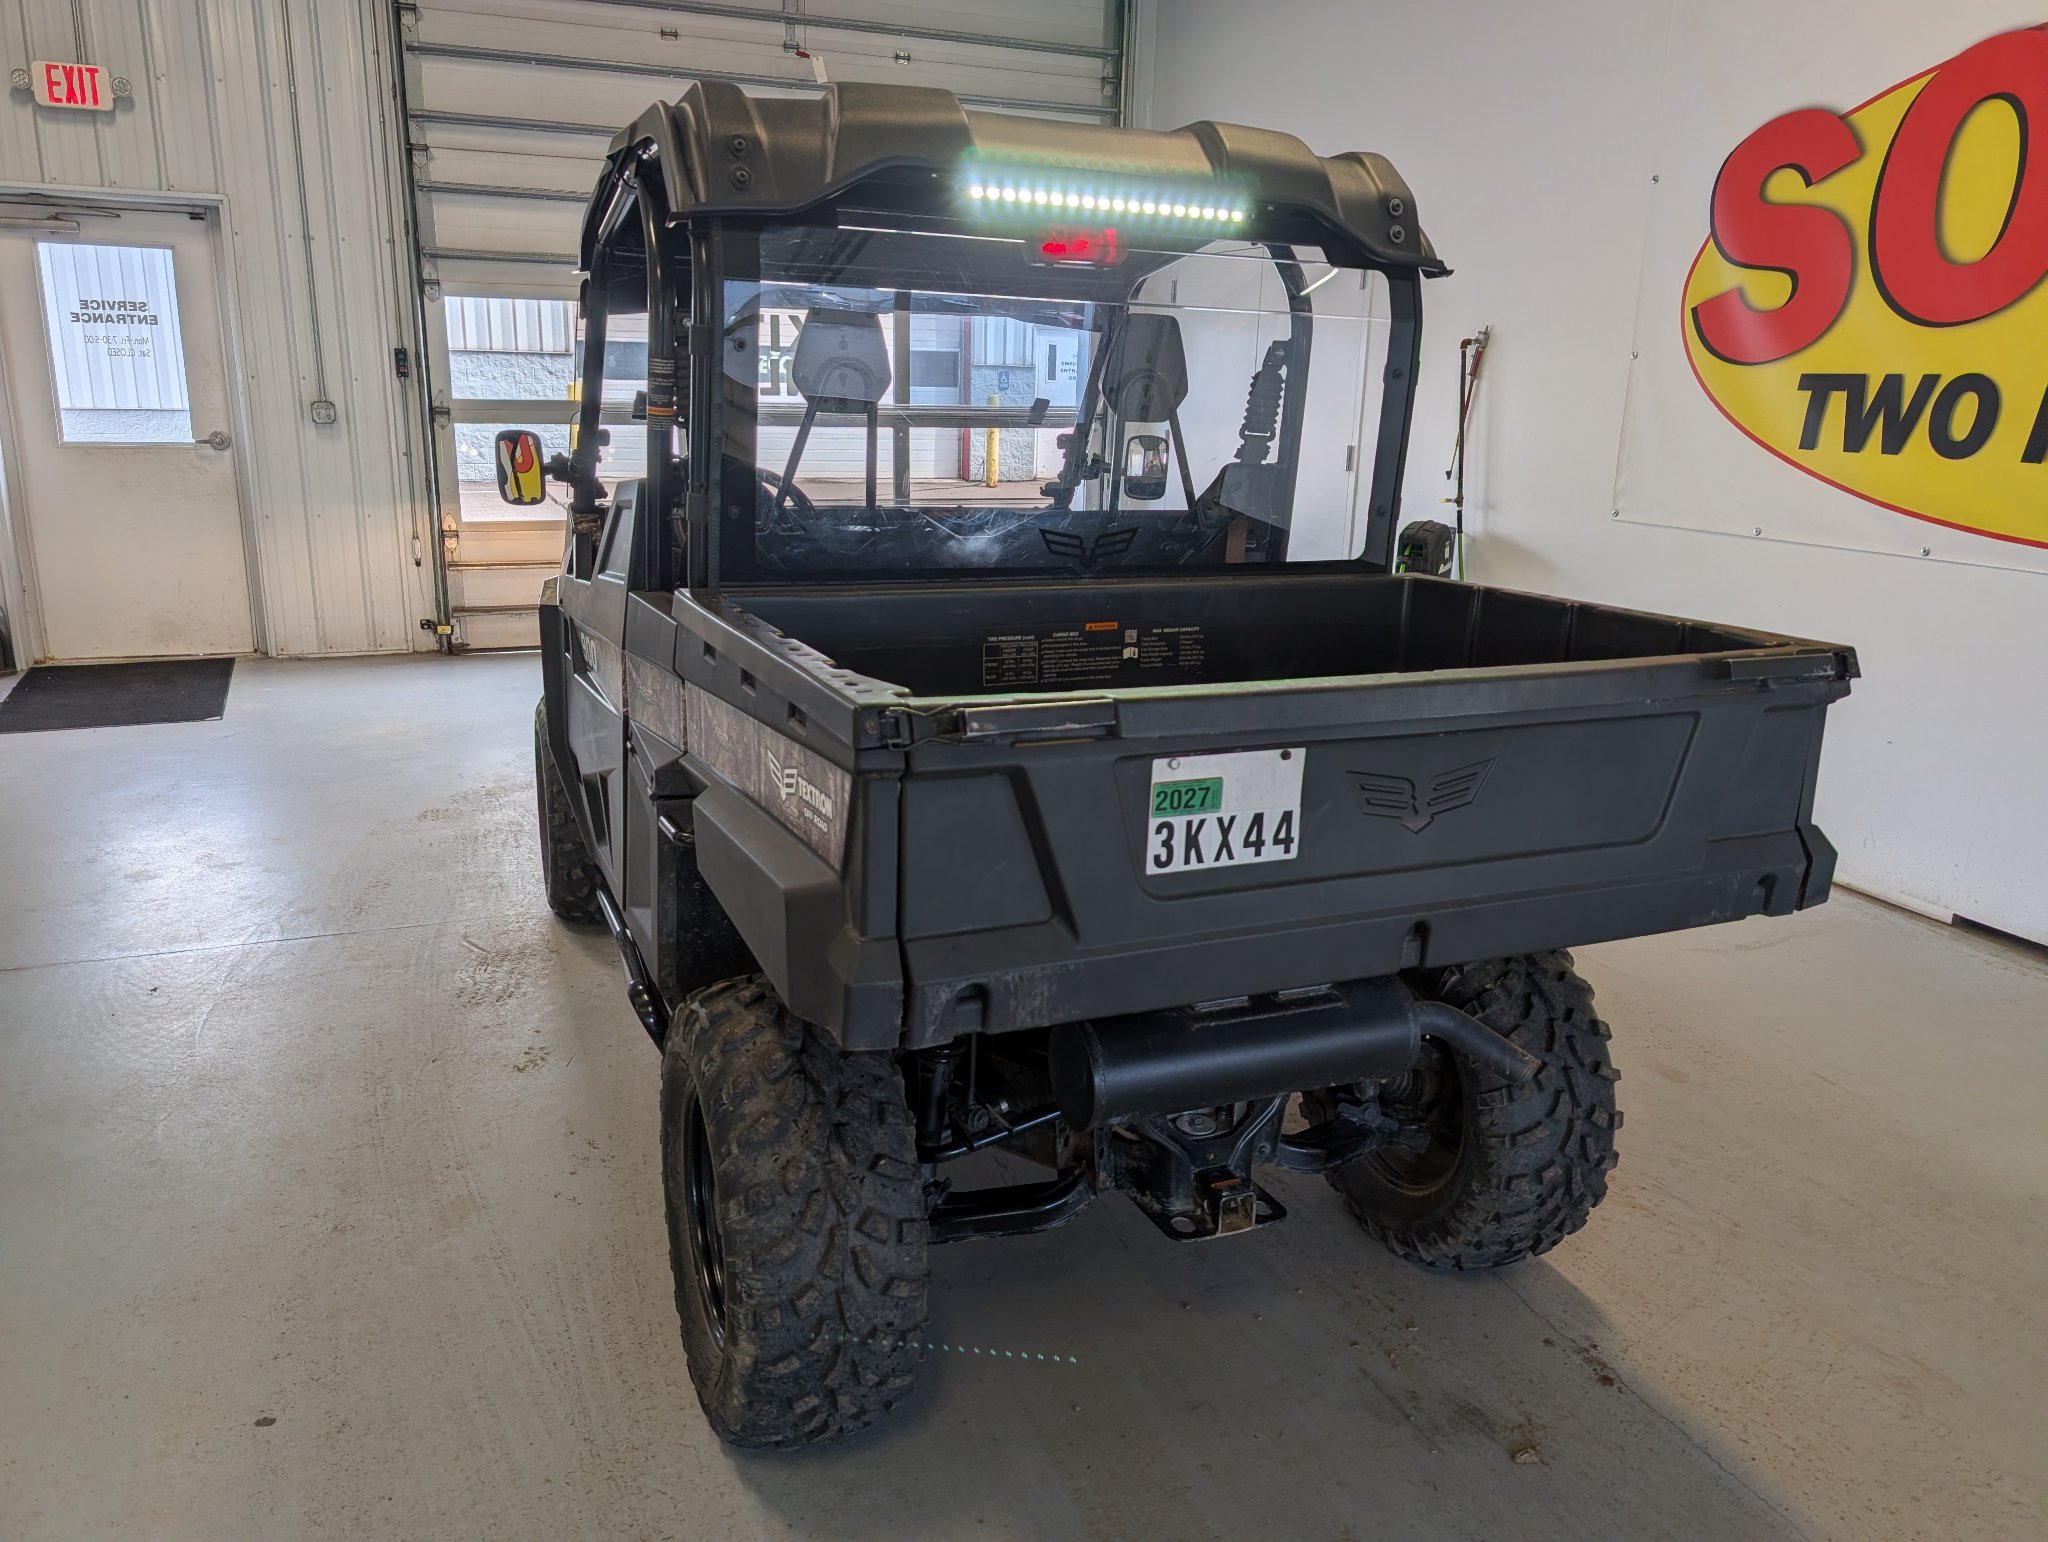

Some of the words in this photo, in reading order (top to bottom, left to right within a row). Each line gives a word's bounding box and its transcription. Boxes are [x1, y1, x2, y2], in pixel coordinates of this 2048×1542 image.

[45, 63, 99, 107] EXIT
[1796, 373, 2000, 461] TWO
[797, 775, 833, 820] TEXTRON
[1154, 785, 1212, 812] 2027
[1153, 809, 1295, 869] 3KX44
